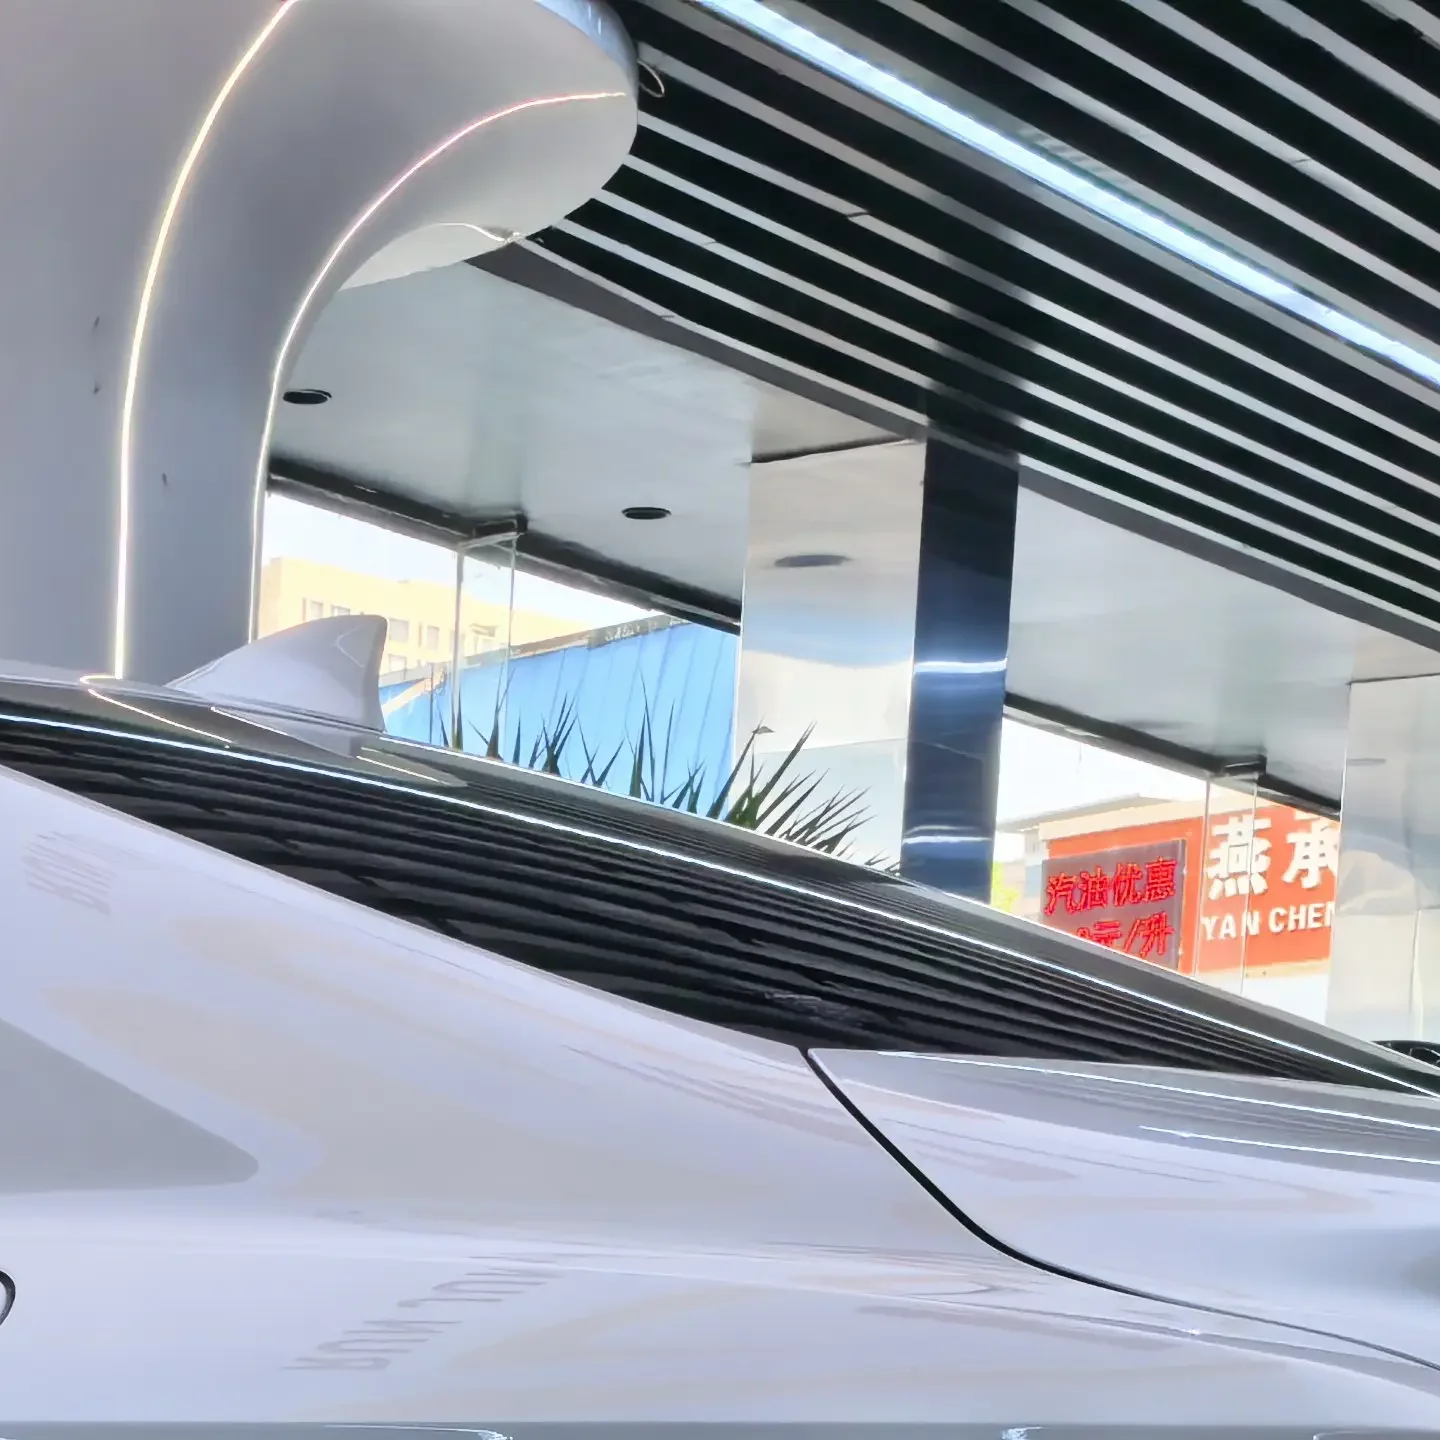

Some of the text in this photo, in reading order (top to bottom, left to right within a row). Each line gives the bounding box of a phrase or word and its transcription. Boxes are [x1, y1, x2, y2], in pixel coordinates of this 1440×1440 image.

[1203, 810, 1341, 901] 燕承
[1044, 856, 1178, 917] 汽油优惠
[1200, 908, 1261, 942] YAN
